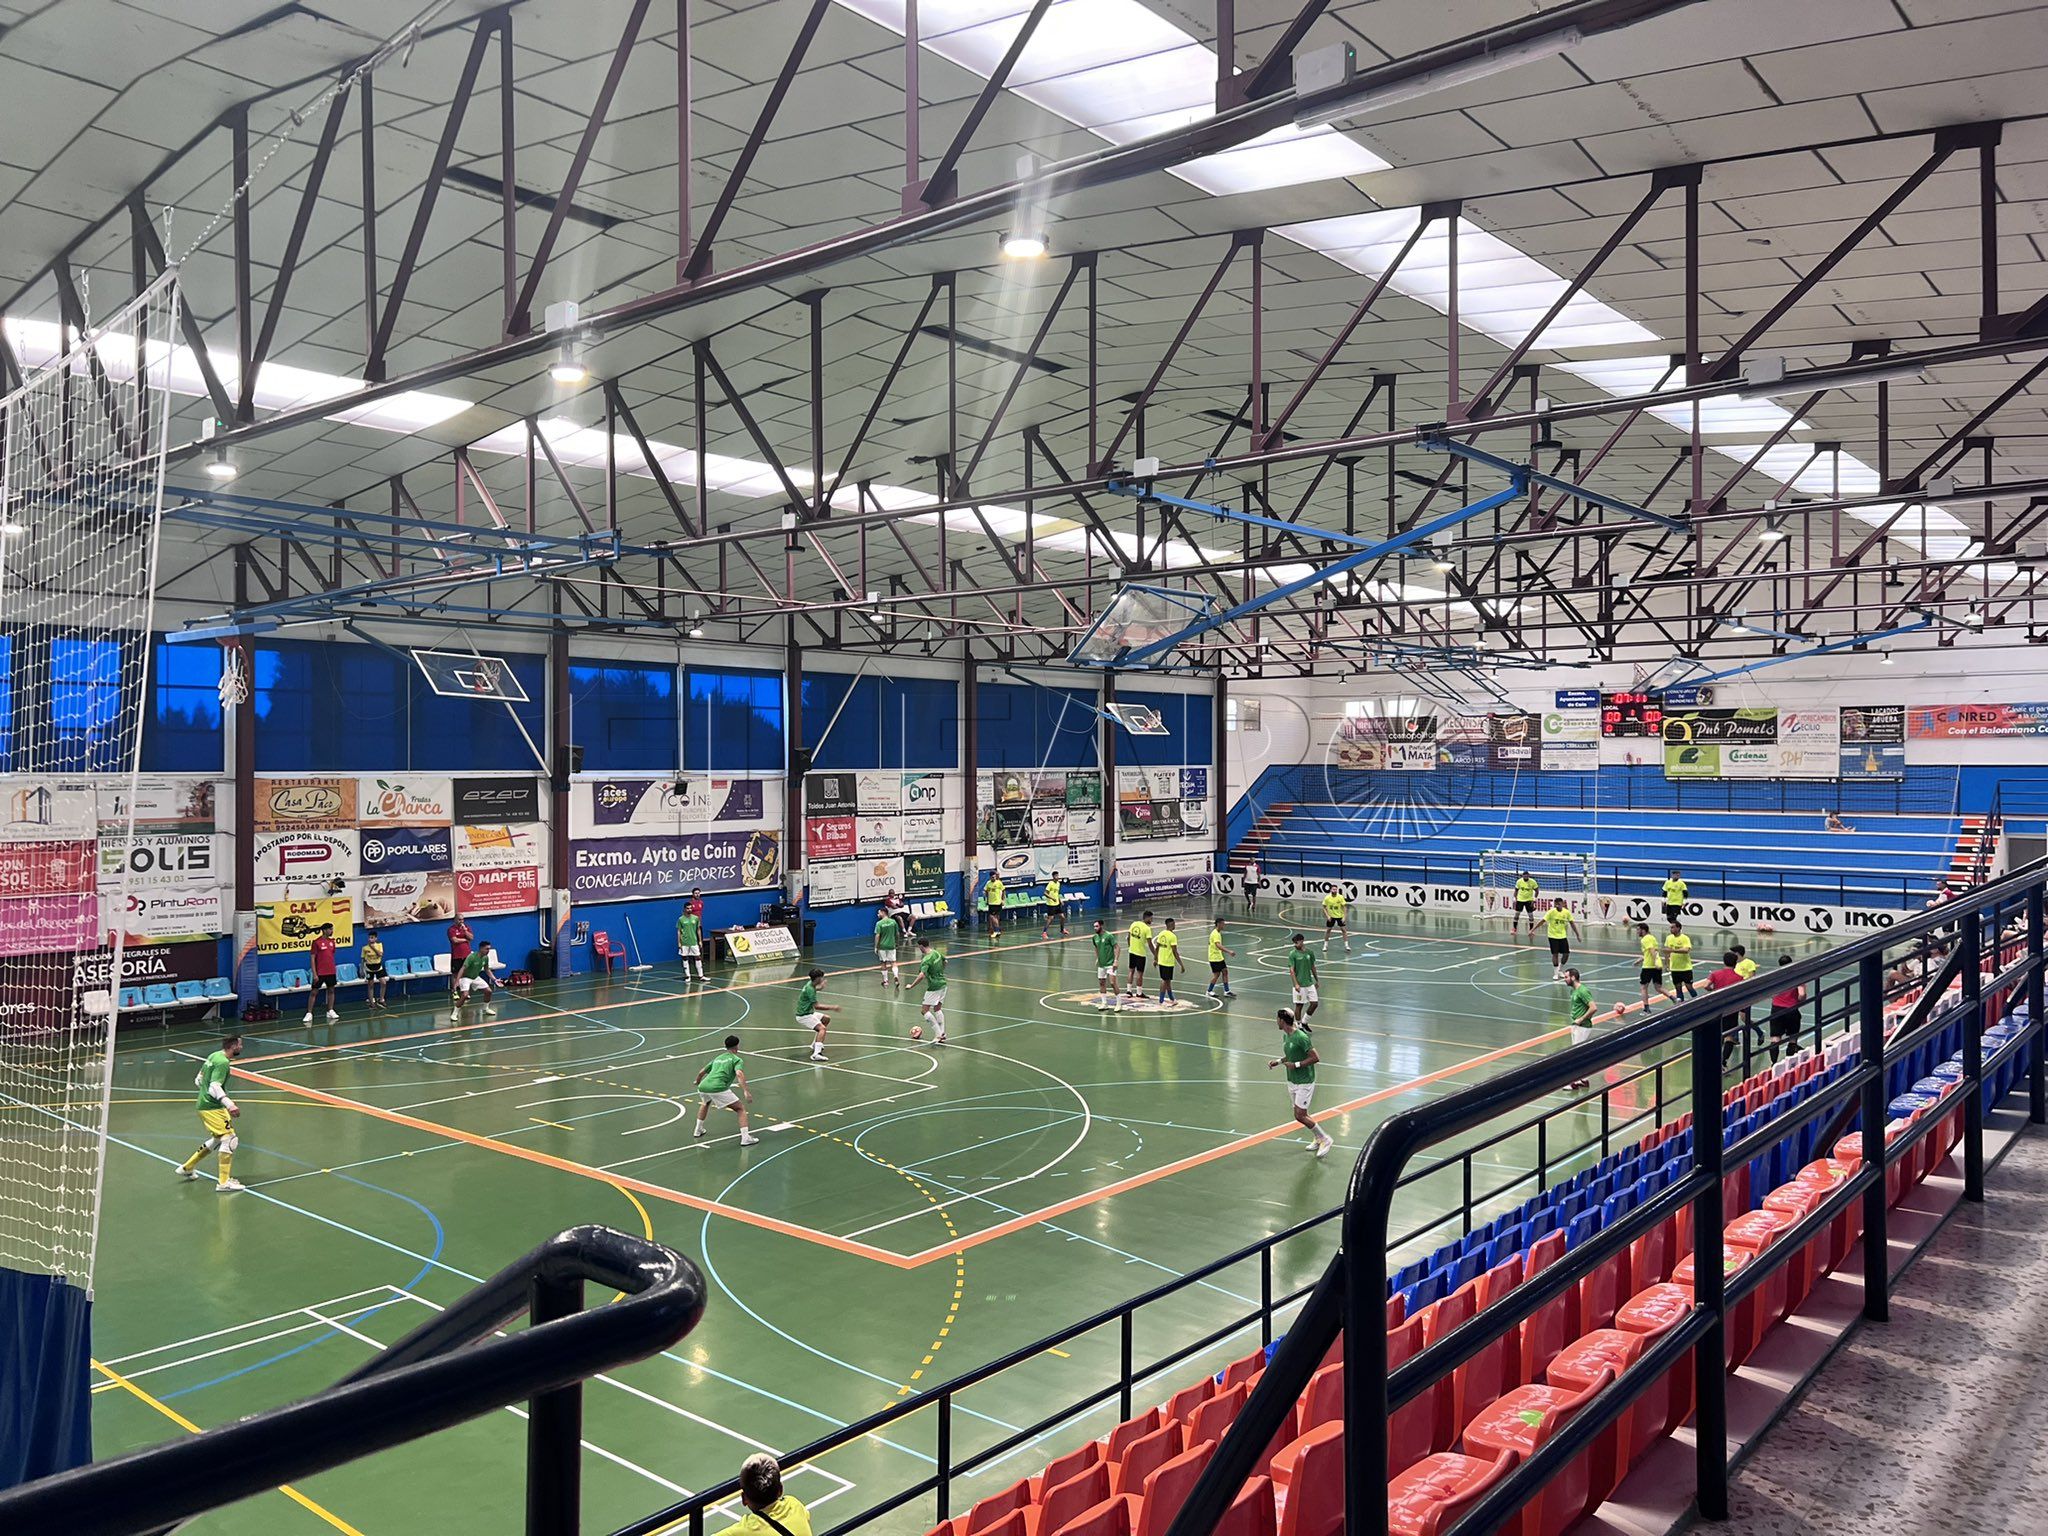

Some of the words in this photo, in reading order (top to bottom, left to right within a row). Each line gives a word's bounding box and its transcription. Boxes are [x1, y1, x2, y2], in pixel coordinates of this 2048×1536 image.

[1870, 707, 1899, 715] LACADOS
[1936, 710, 1997, 723] CONRED
[1694, 722, 1720, 738] Pub
[1948, 727, 1967, 735] Con
[1980, 726, 2036, 734] Balonmano
[1408, 751, 1433, 760] MATA
[274, 790, 303, 811] Casa
[305, 788, 334, 810] Paco
[604, 789, 628, 797] aces
[603, 796, 628, 804] europe
[668, 792, 708, 808] COÍN
[826, 822, 852, 831] Seguros
[147, 838, 153, 846] Y
[156, 836, 210, 846] ALUMINIOS
[826, 832, 848, 840] Bilbao
[254, 834, 296, 862] APOSTANDO
[296, 832, 312, 841] POR
[324, 836, 352, 858] DEPORTE
[386, 844, 448, 856] POPULARES
[576, 850, 637, 868] Excmo.
[641, 846, 678, 866] Ayto
[681, 845, 700, 861] de
[704, 842, 736, 860] Coín
[575, 870, 652, 890] CONCEJALIA
[657, 870, 674, 884] DE
[679, 865, 736, 882] DEPORTES
[906, 868, 913, 876] LA
[914, 866, 942, 876] TERRAZA
[1132, 867, 1154, 876] Antonio
[478, 871, 536, 885] MAPFRE
[866, 876, 896, 888] COINCO
[1242, 877, 1270, 890] IO
[1366, 884, 1398, 898] INKO
[1434, 888, 1470, 902] INKO
[1662, 902, 1704, 916] IKO
[1750, 906, 1796, 922] INKO
[1845, 912, 1894, 928] INKO
[754, 929, 784, 938] RECICLA
[256, 942, 279, 952] AUTO
[281, 939, 314, 950] DESGU
